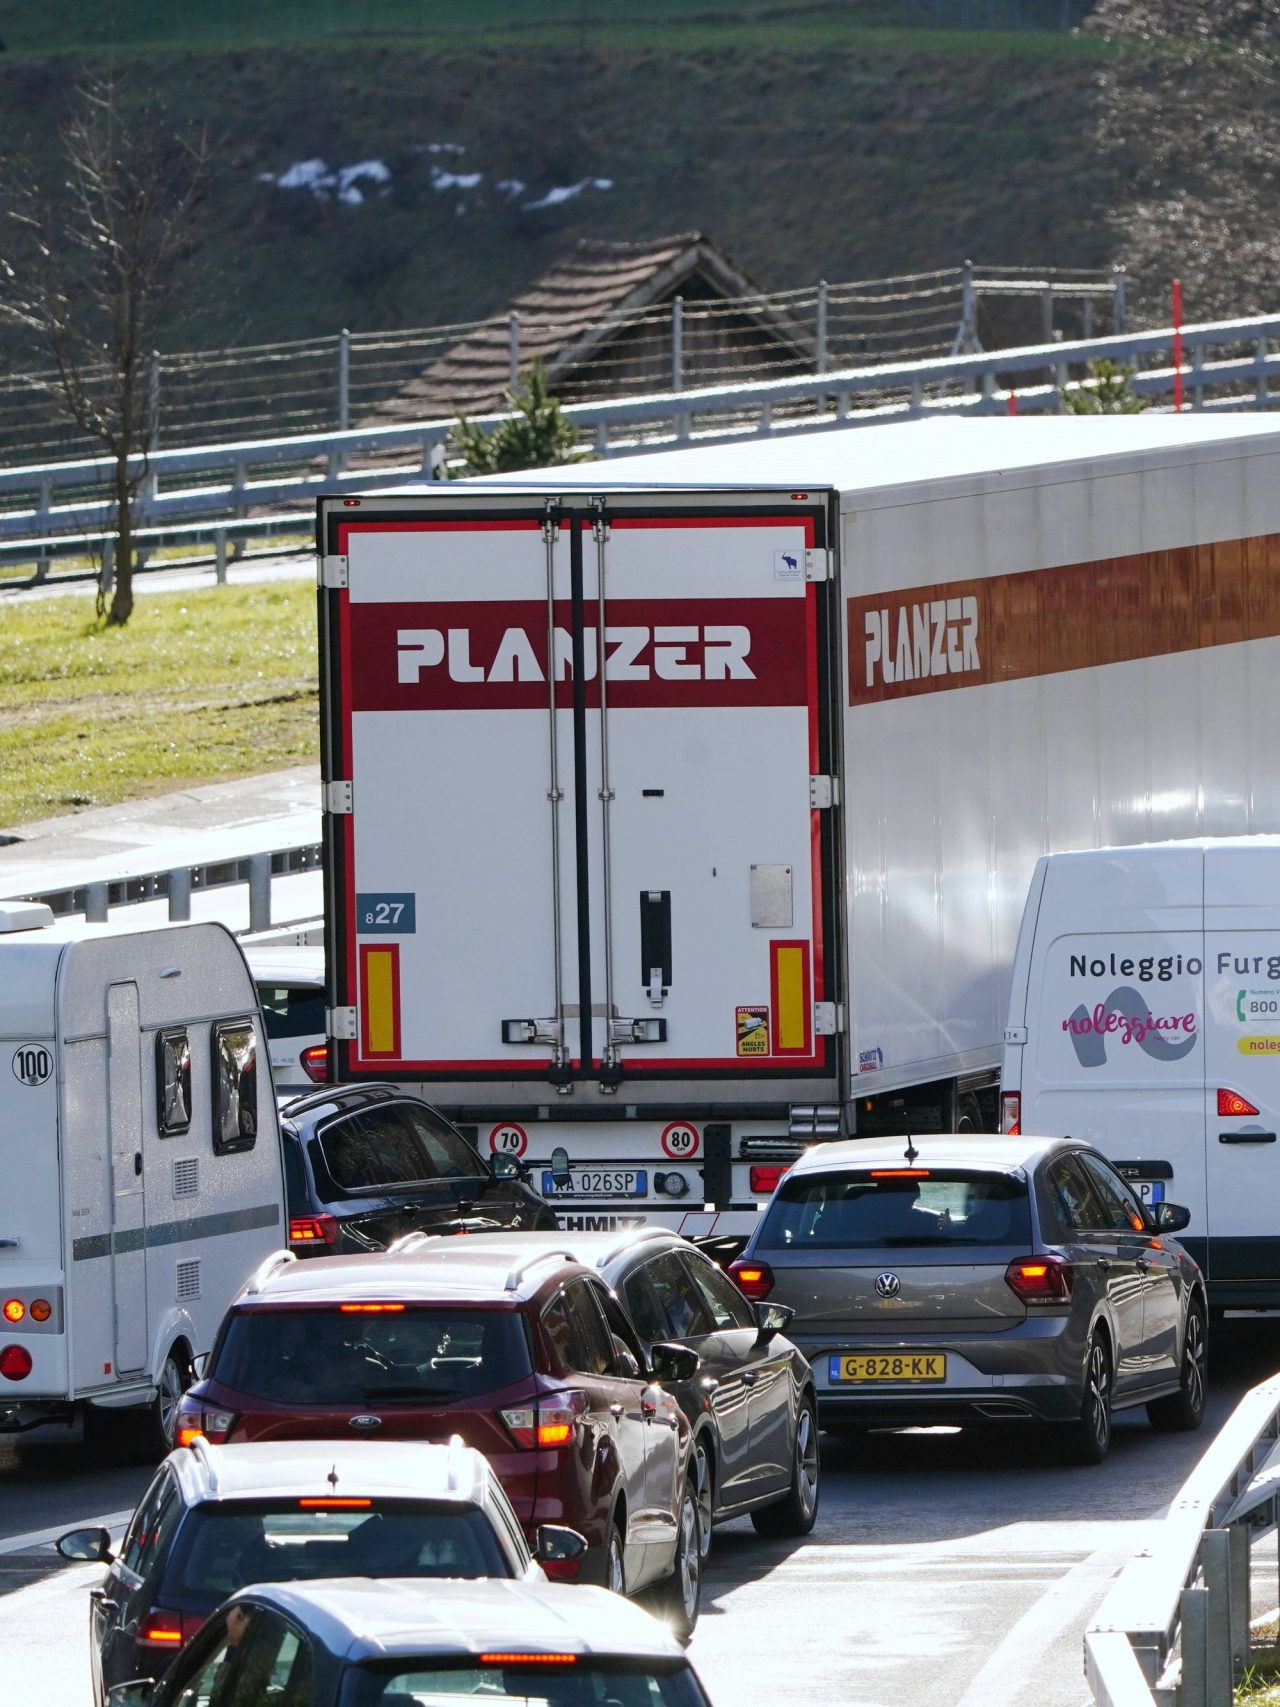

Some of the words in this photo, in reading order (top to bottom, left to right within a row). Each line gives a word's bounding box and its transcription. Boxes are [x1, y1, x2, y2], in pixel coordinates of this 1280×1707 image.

[397, 624, 758, 684] PLANZER
[864, 596, 981, 688] PLANZER
[1070, 953, 1203, 982] Noleggio
[1250, 1001, 1277, 1012] 800
[1062, 1003, 1197, 1045] noleggiare
[17, 1050, 49, 1080] 100
[501, 1132, 520, 1149] 70
[671, 1131, 691, 1148] 80
[845, 1358, 937, 1377] G-828-KK
